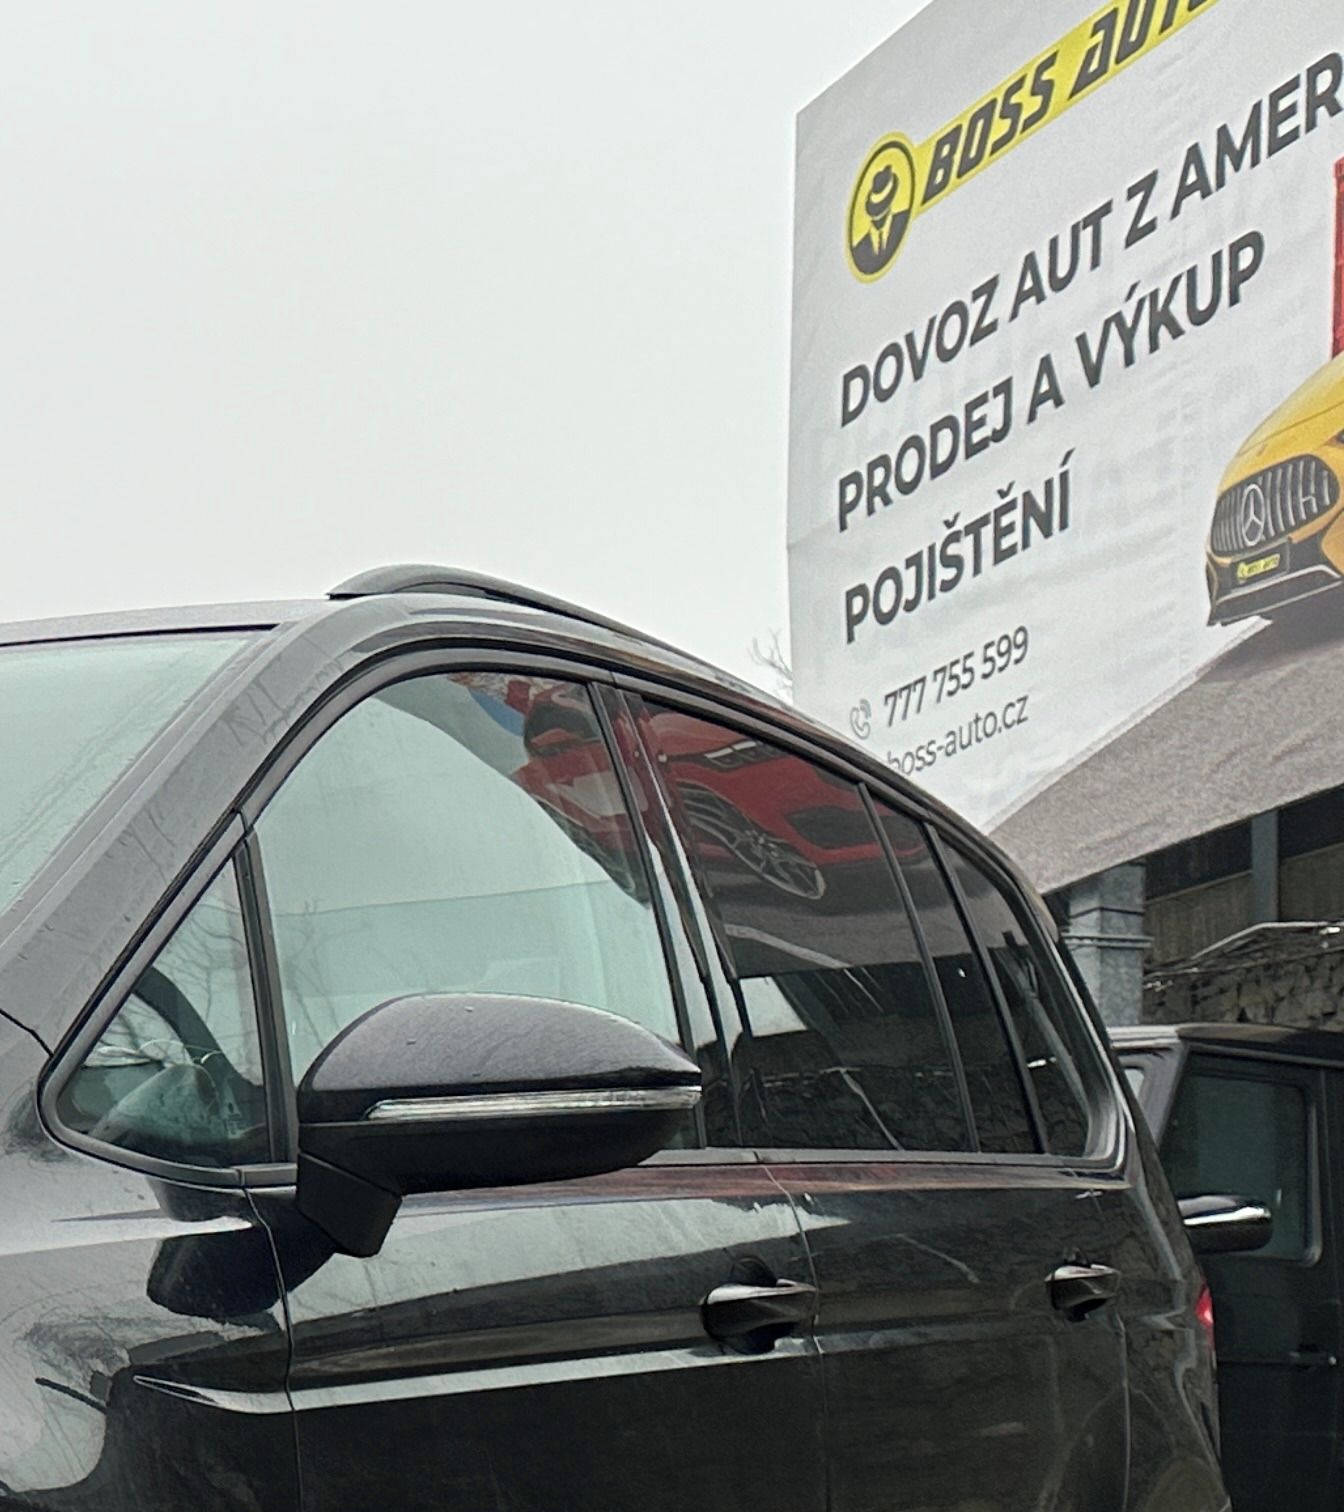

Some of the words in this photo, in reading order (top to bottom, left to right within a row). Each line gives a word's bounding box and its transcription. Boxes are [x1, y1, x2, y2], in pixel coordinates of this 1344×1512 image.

[921, 49, 1060, 206] BOSS
[1067, 0, 1208, 101] AU
[840, 274, 1000, 428] DOVOZ
[1009, 199, 1113, 323] AUT
[1124, 169, 1159, 249] Z
[1169, 52, 1344, 220] AMER
[838, 376, 1014, 532] PRODEJ
[1027, 353, 1065, 424] A
[1075, 230, 1265, 389] VÝKUP
[845, 448, 1075, 644] POJIŠTĚNÍ
[884, 675, 927, 728] 777
[932, 651, 975, 704] 755
[980, 625, 1029, 680] 599
